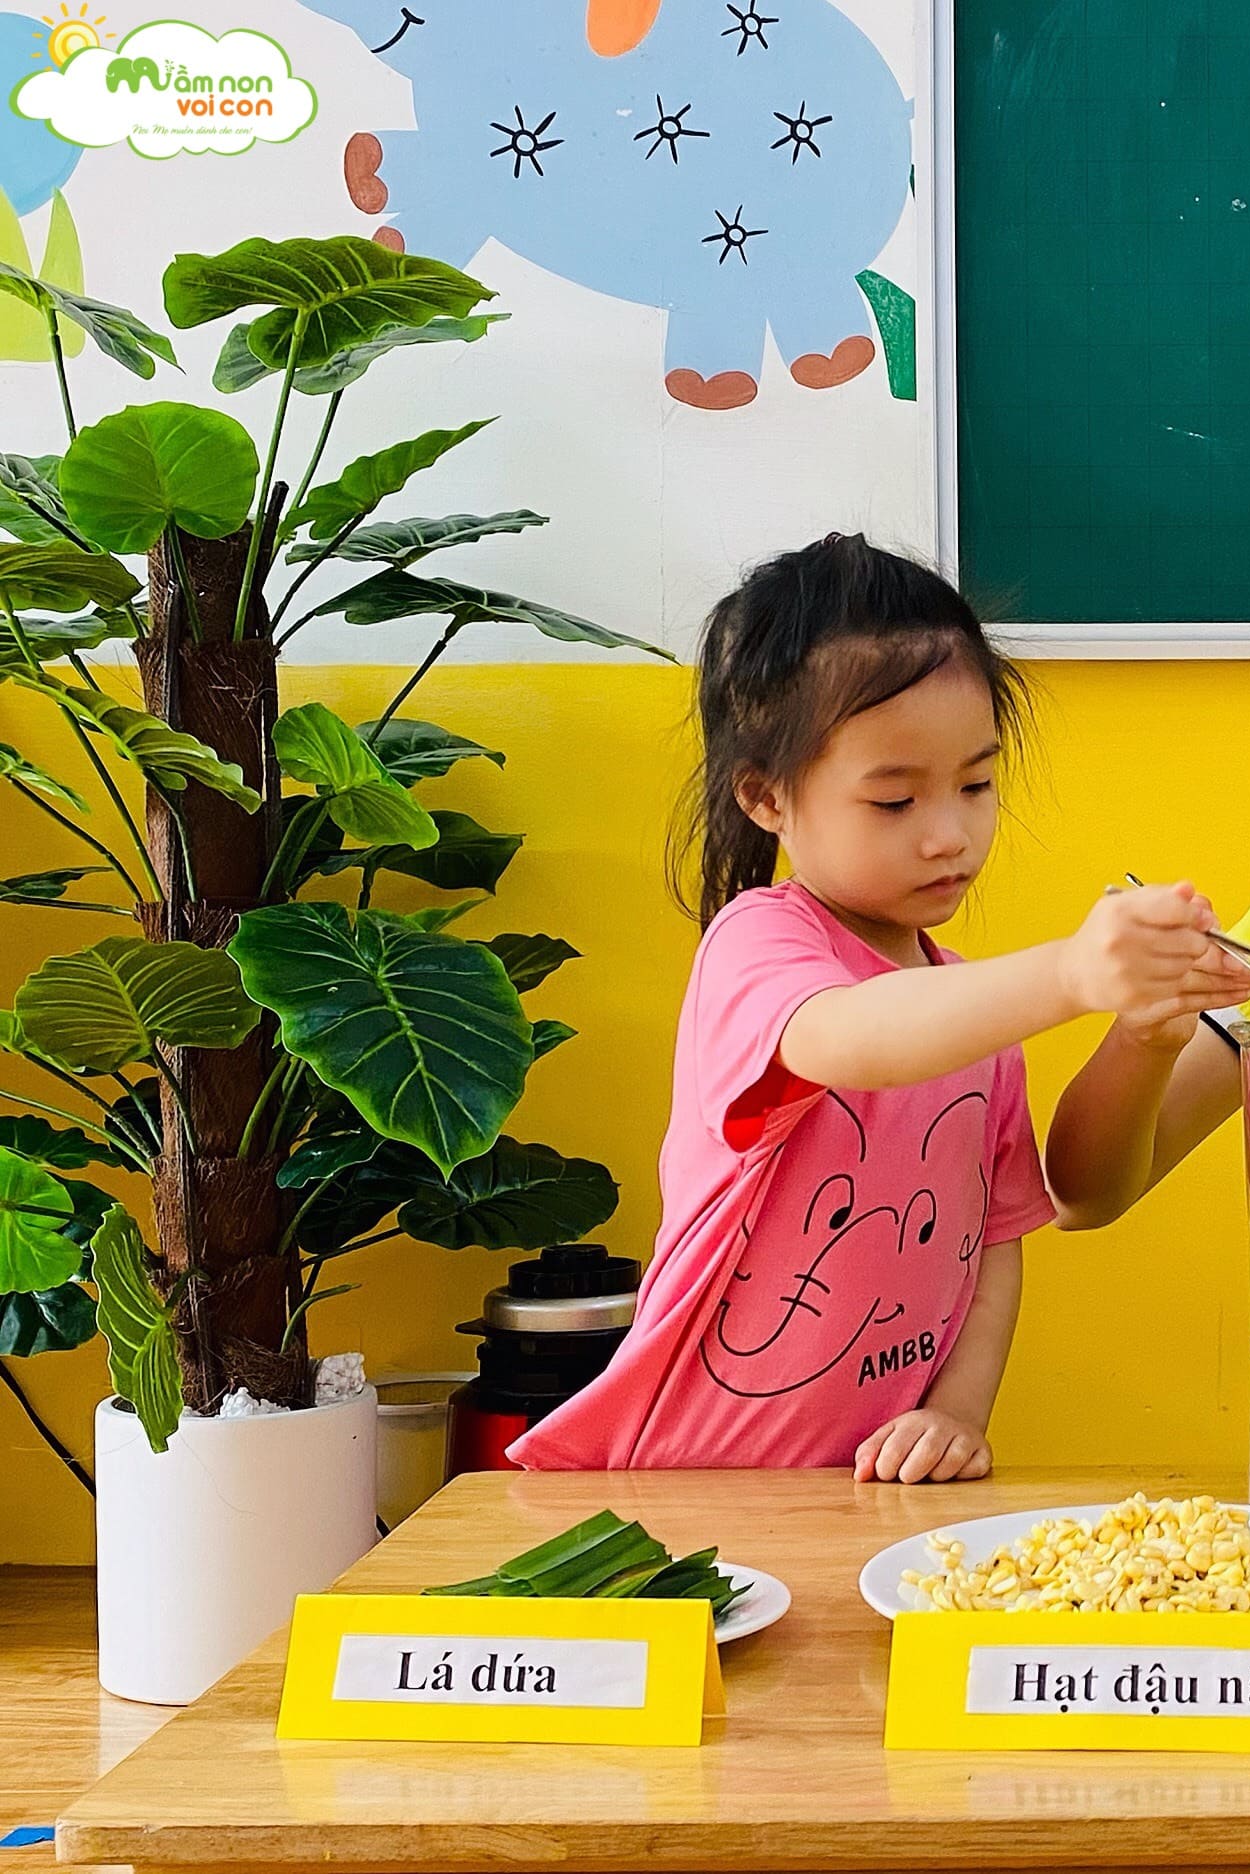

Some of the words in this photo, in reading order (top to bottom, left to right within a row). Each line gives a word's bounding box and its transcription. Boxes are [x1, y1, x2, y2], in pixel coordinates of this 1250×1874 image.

[858, 1331, 936, 1387] AMBB
[394, 1650, 454, 1691] Lá
[471, 1652, 557, 1693] dứa
[1011, 1663, 1098, 1713] Hạt
[1113, 1663, 1200, 1715] đậu
